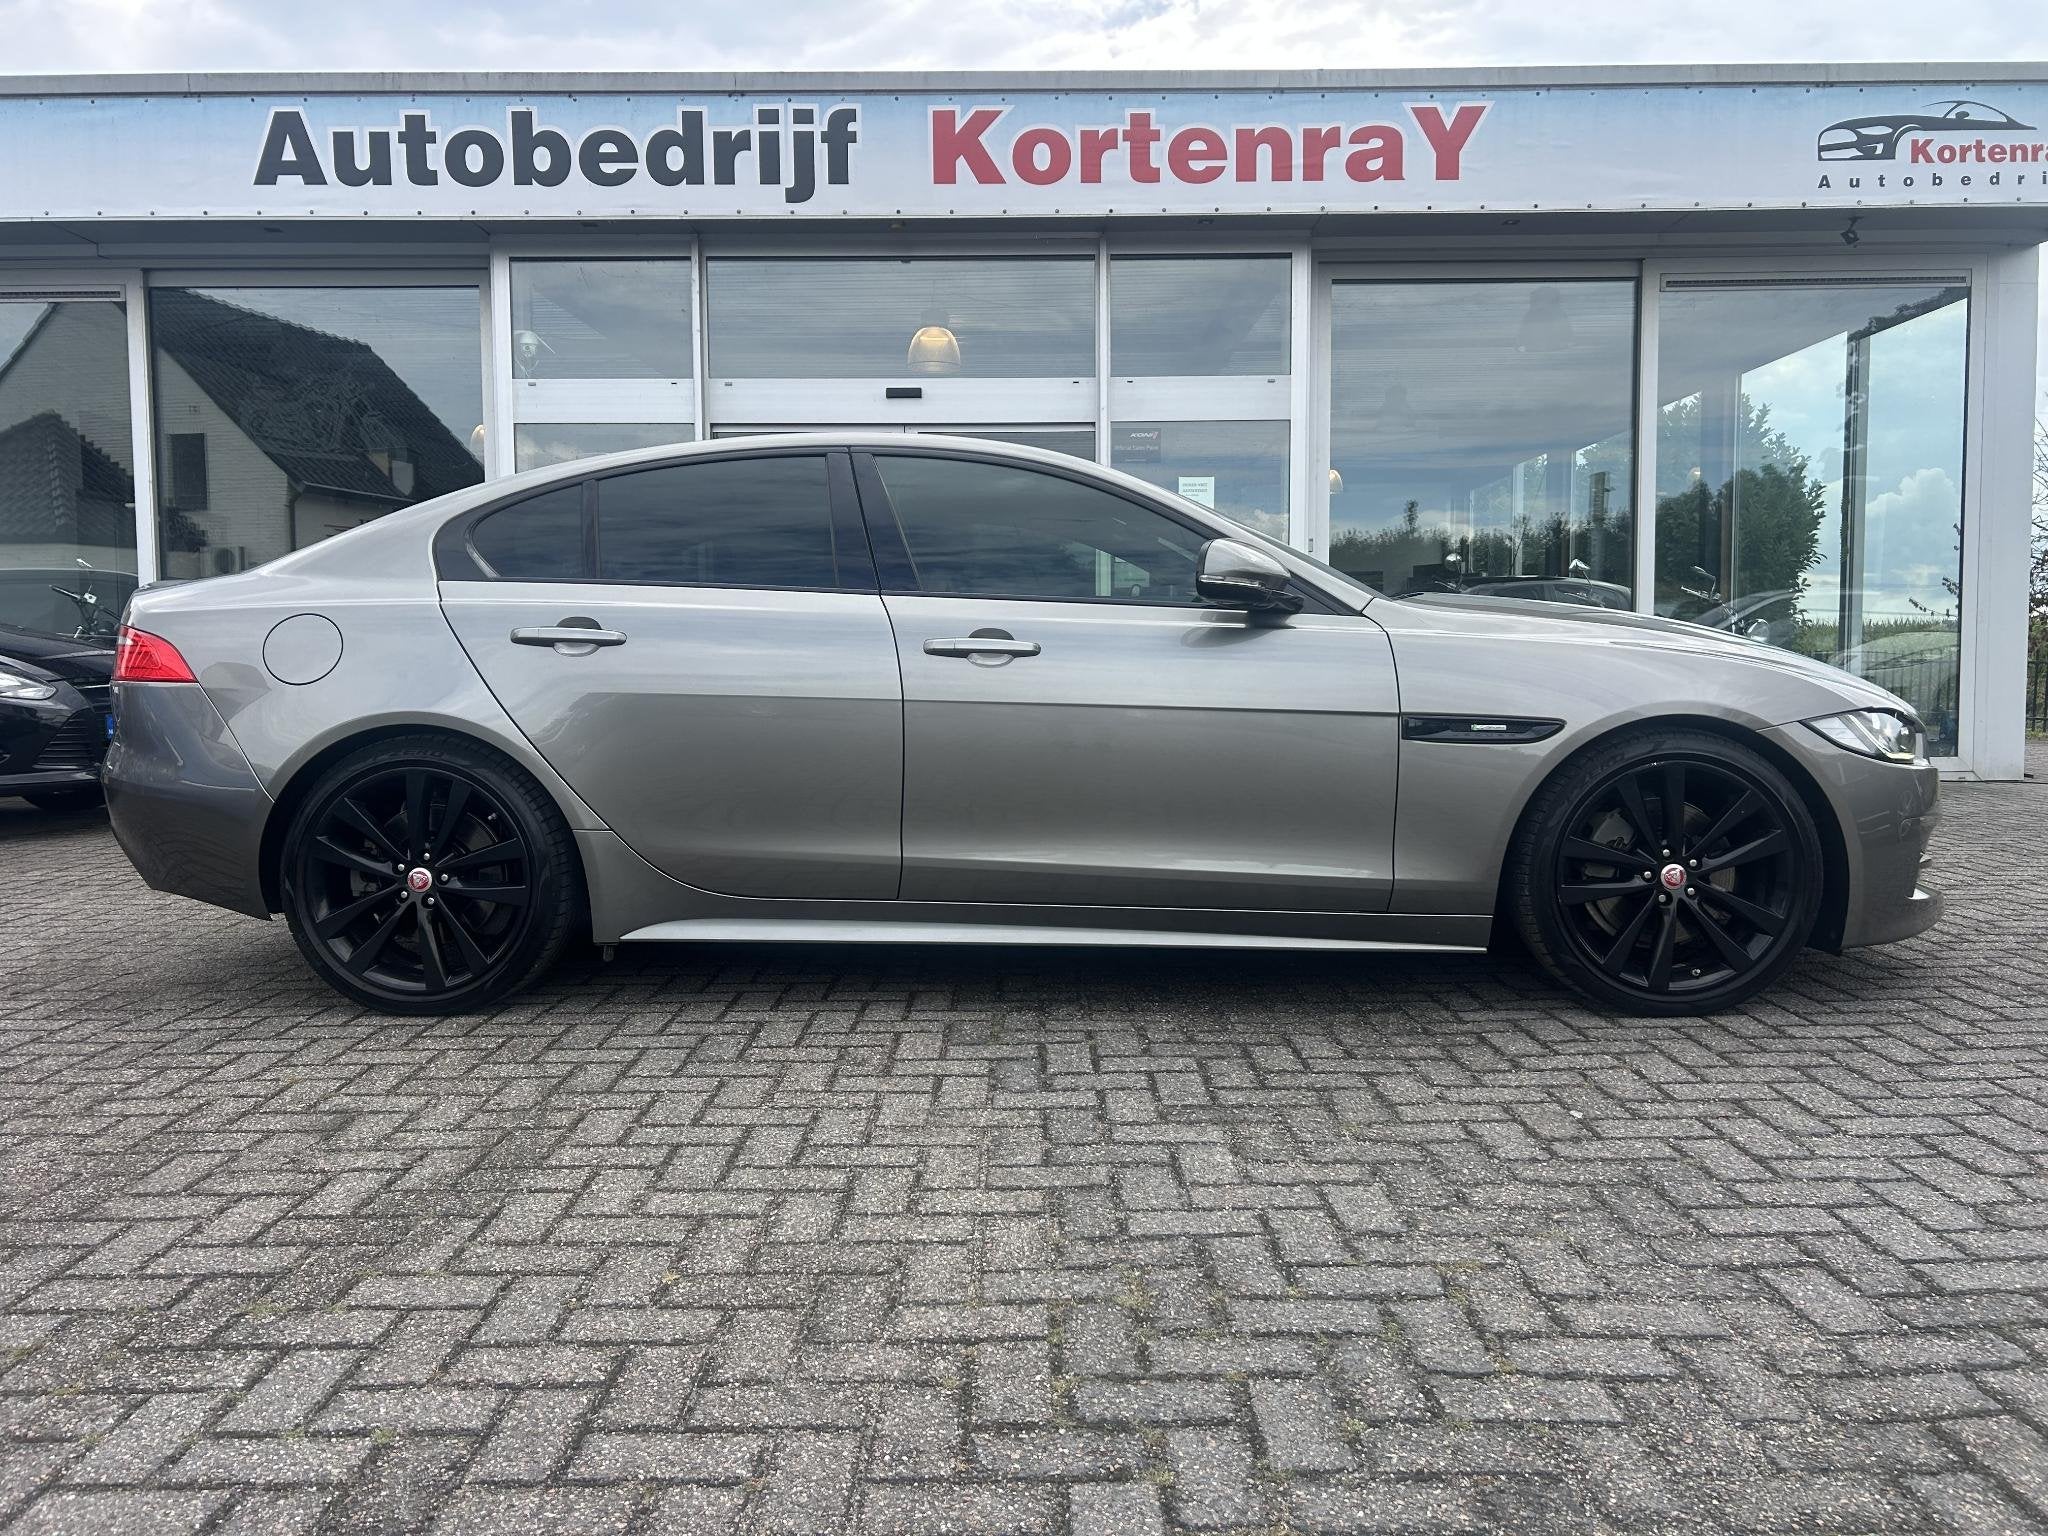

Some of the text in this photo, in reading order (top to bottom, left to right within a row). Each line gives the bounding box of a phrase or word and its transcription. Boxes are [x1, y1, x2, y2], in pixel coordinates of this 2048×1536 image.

[254, 106, 1488, 204] Autobedrijf KortenraY
[1911, 139, 2048, 163] Kortenr
